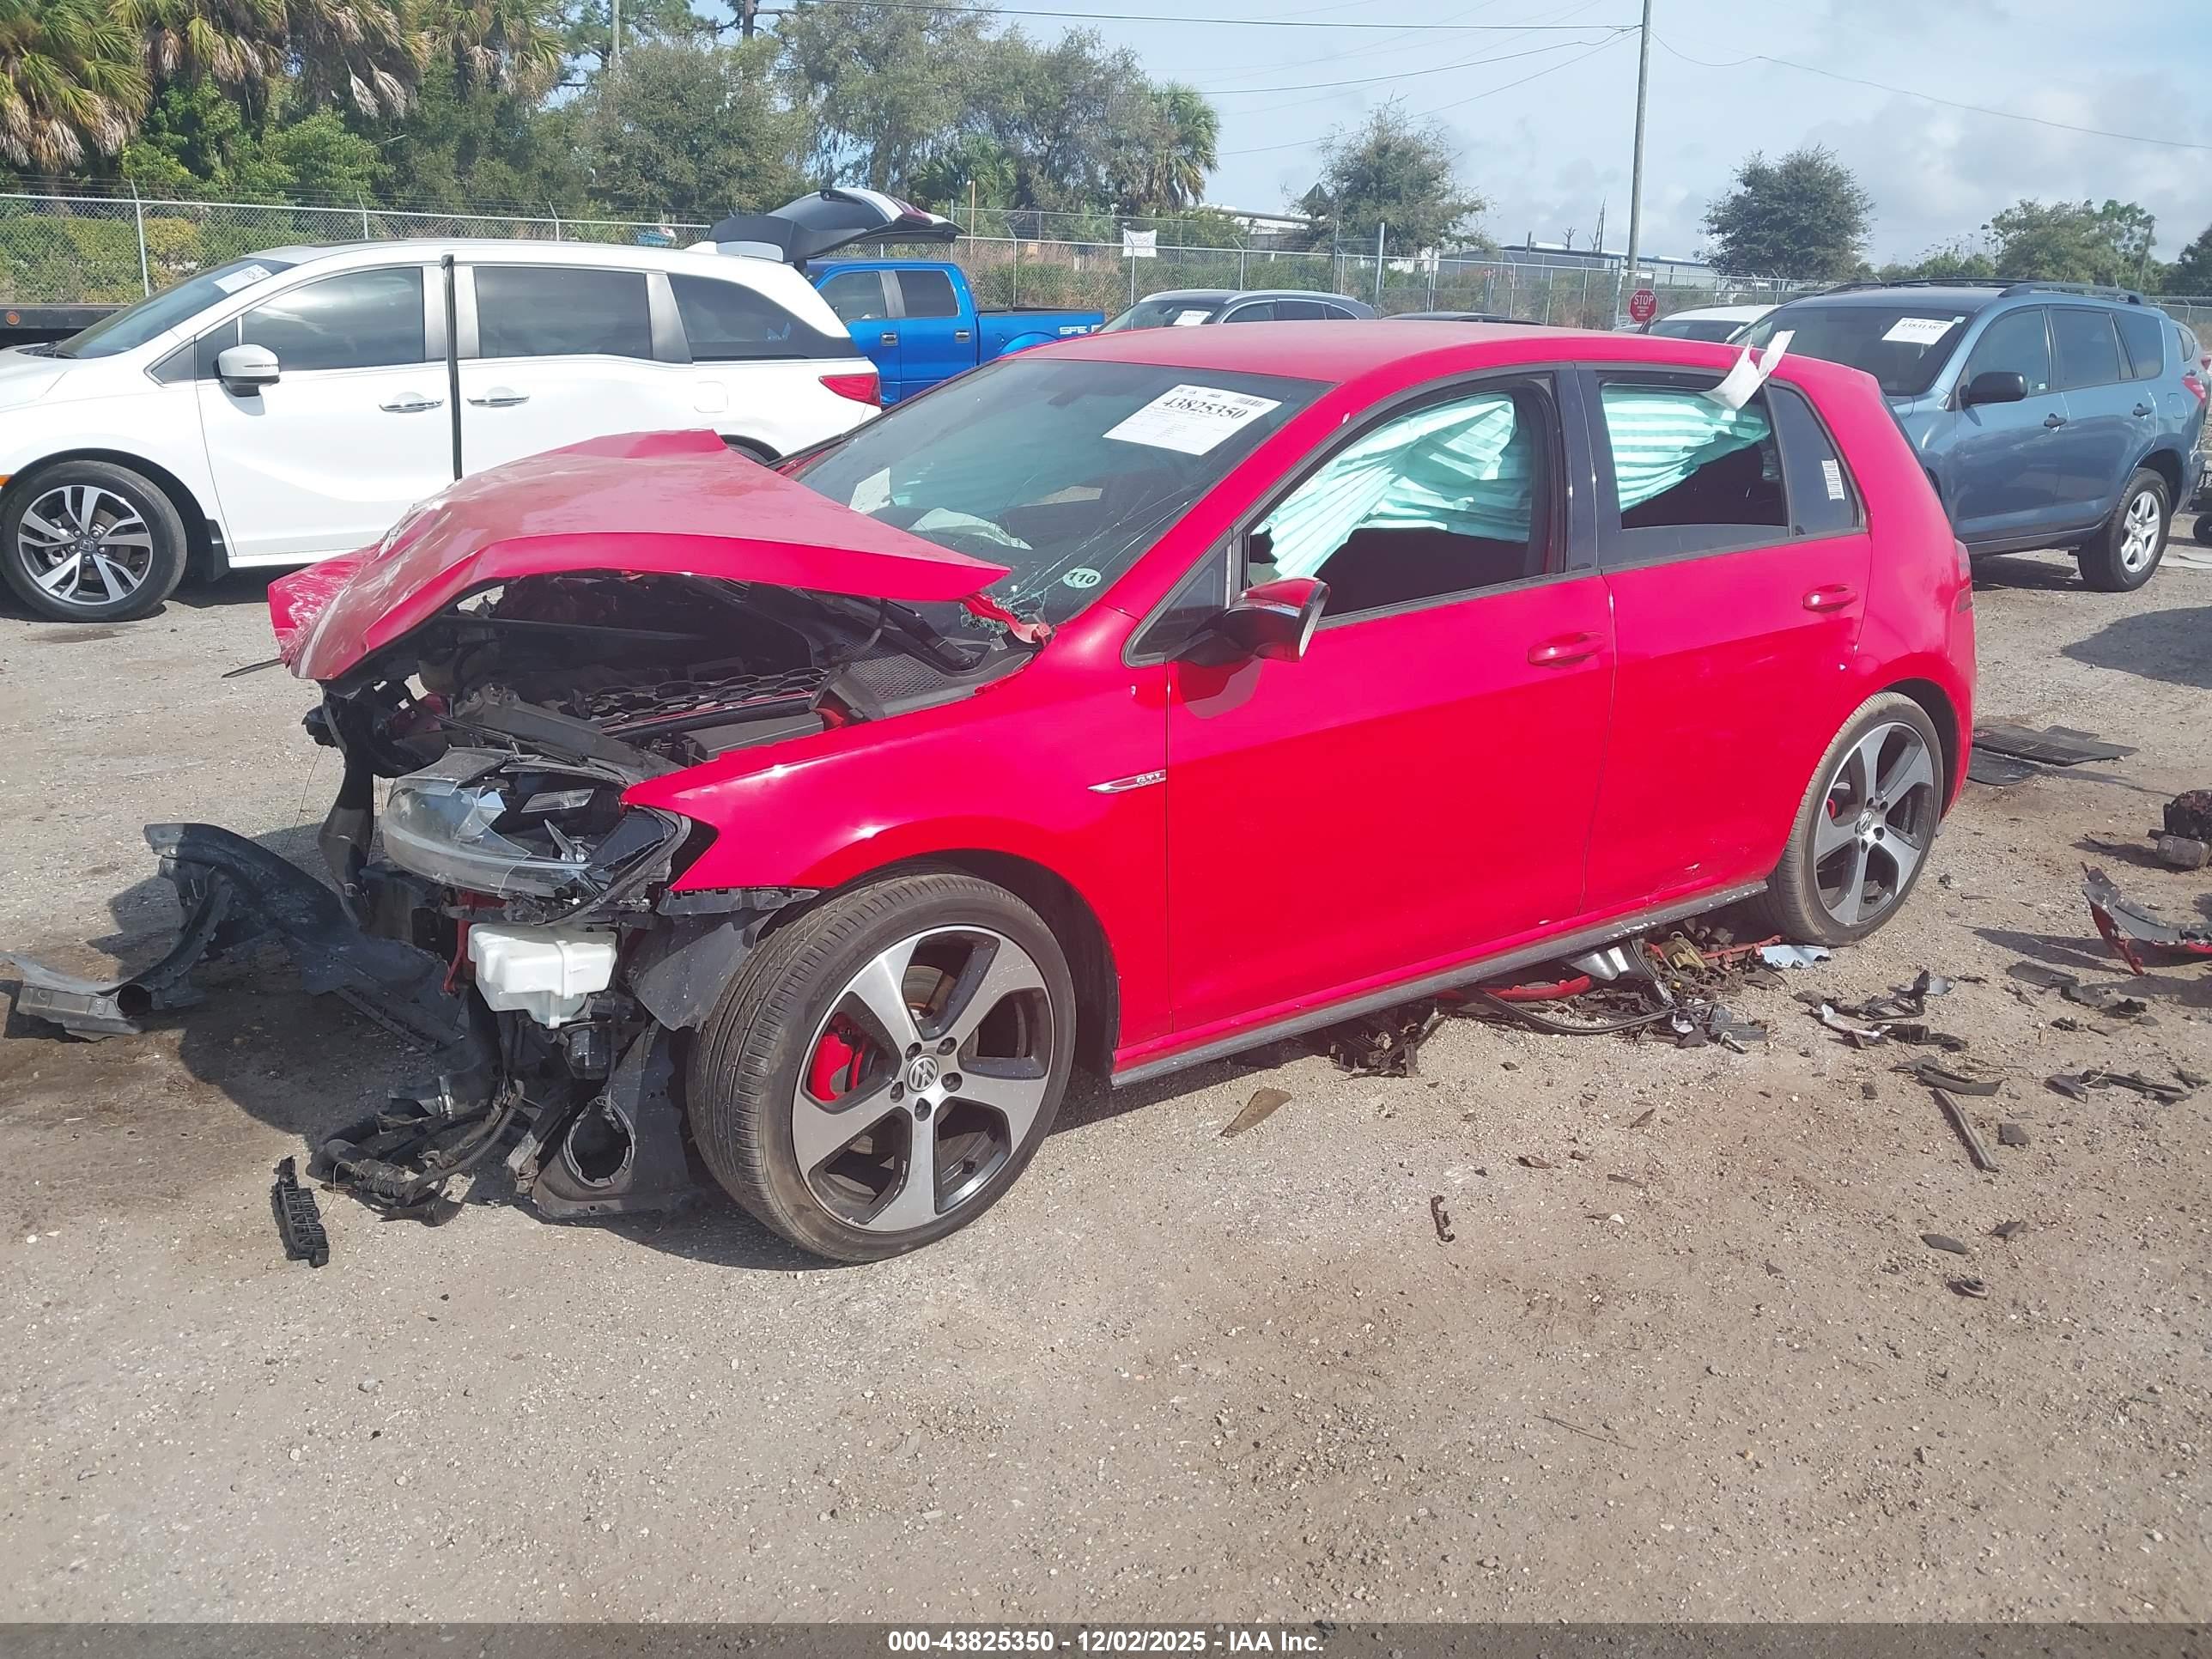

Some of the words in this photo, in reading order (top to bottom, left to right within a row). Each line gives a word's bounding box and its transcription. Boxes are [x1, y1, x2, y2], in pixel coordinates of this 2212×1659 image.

[1634, 295, 1654, 306] STOP
[1162, 397, 1249, 420] 43825350
[1069, 571, 1097, 585] 110
